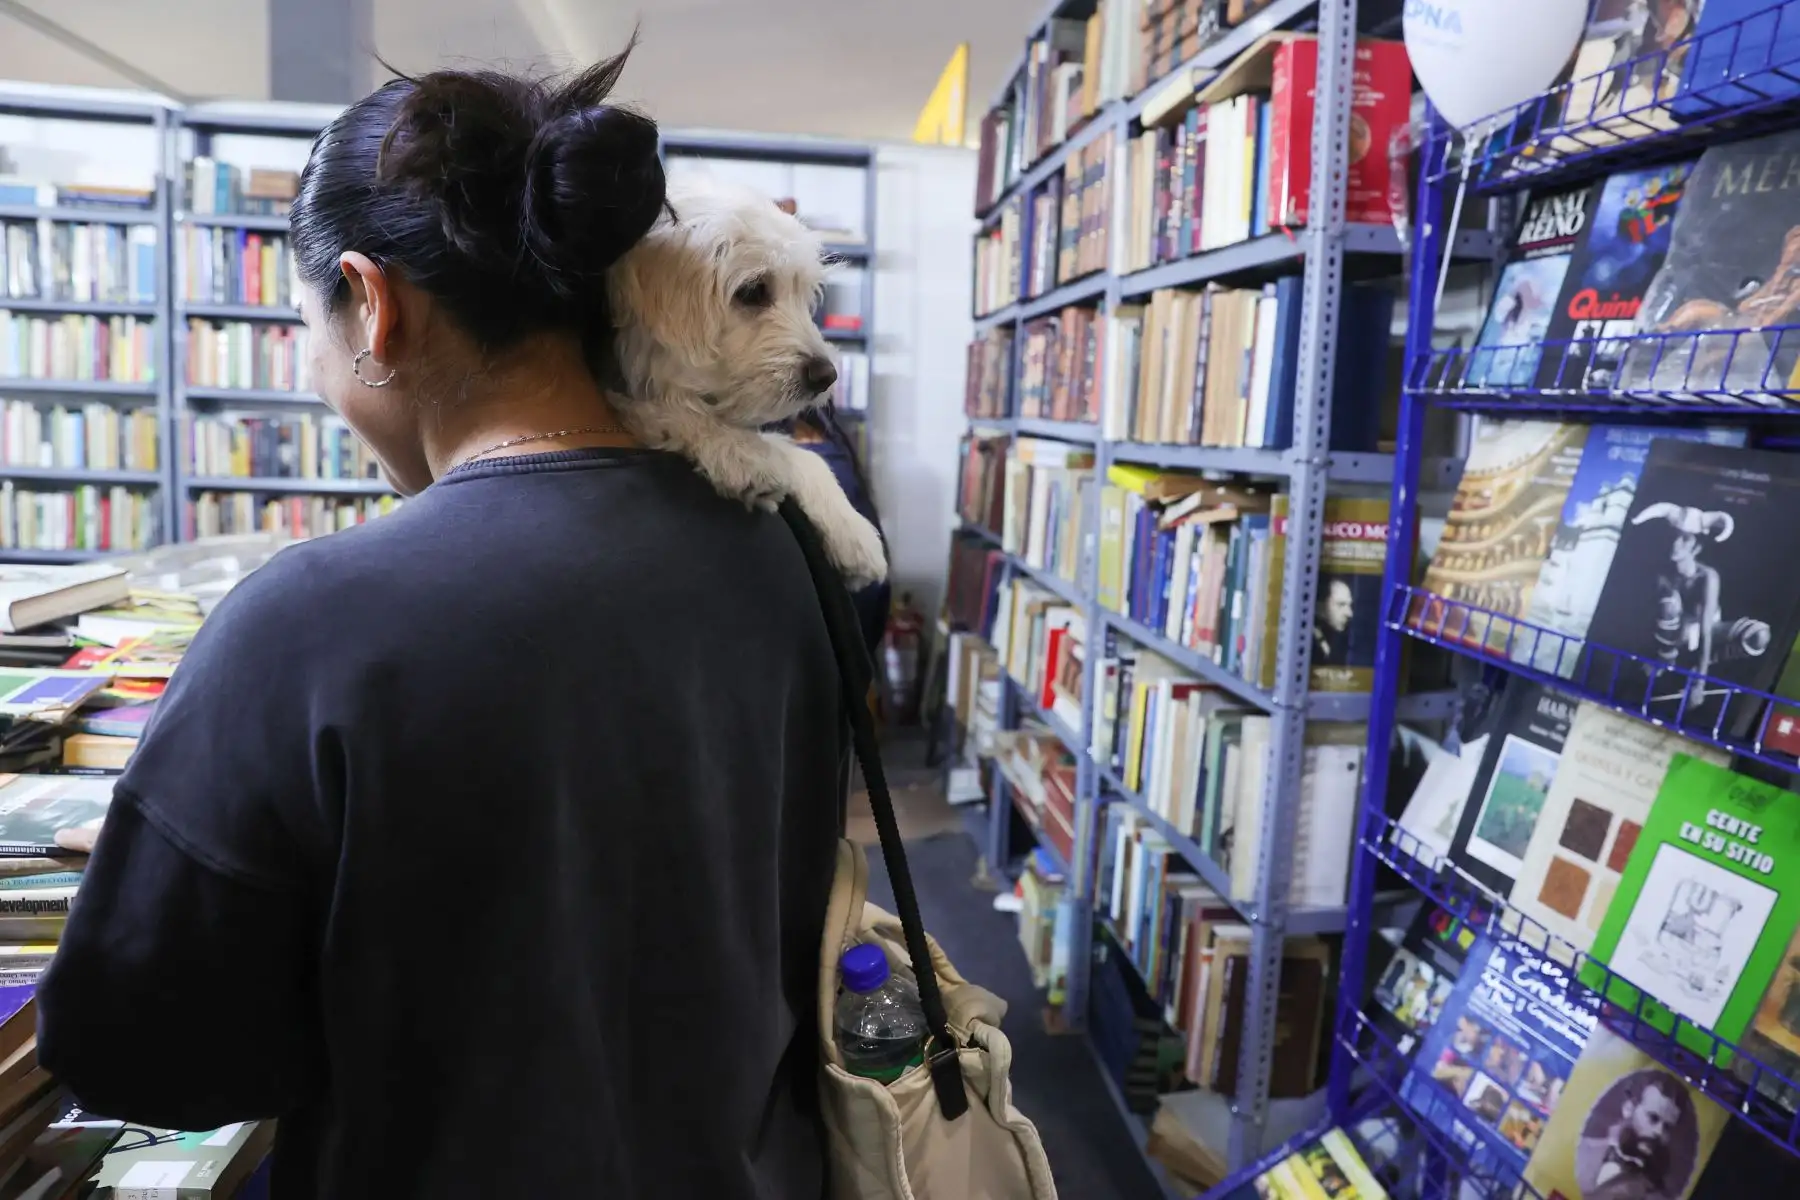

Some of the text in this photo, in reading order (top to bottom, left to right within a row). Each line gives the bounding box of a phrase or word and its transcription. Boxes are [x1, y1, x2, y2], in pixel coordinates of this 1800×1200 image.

[1679, 821, 1776, 876] EN SU SITIO
[1706, 807, 1764, 845] GENTE
